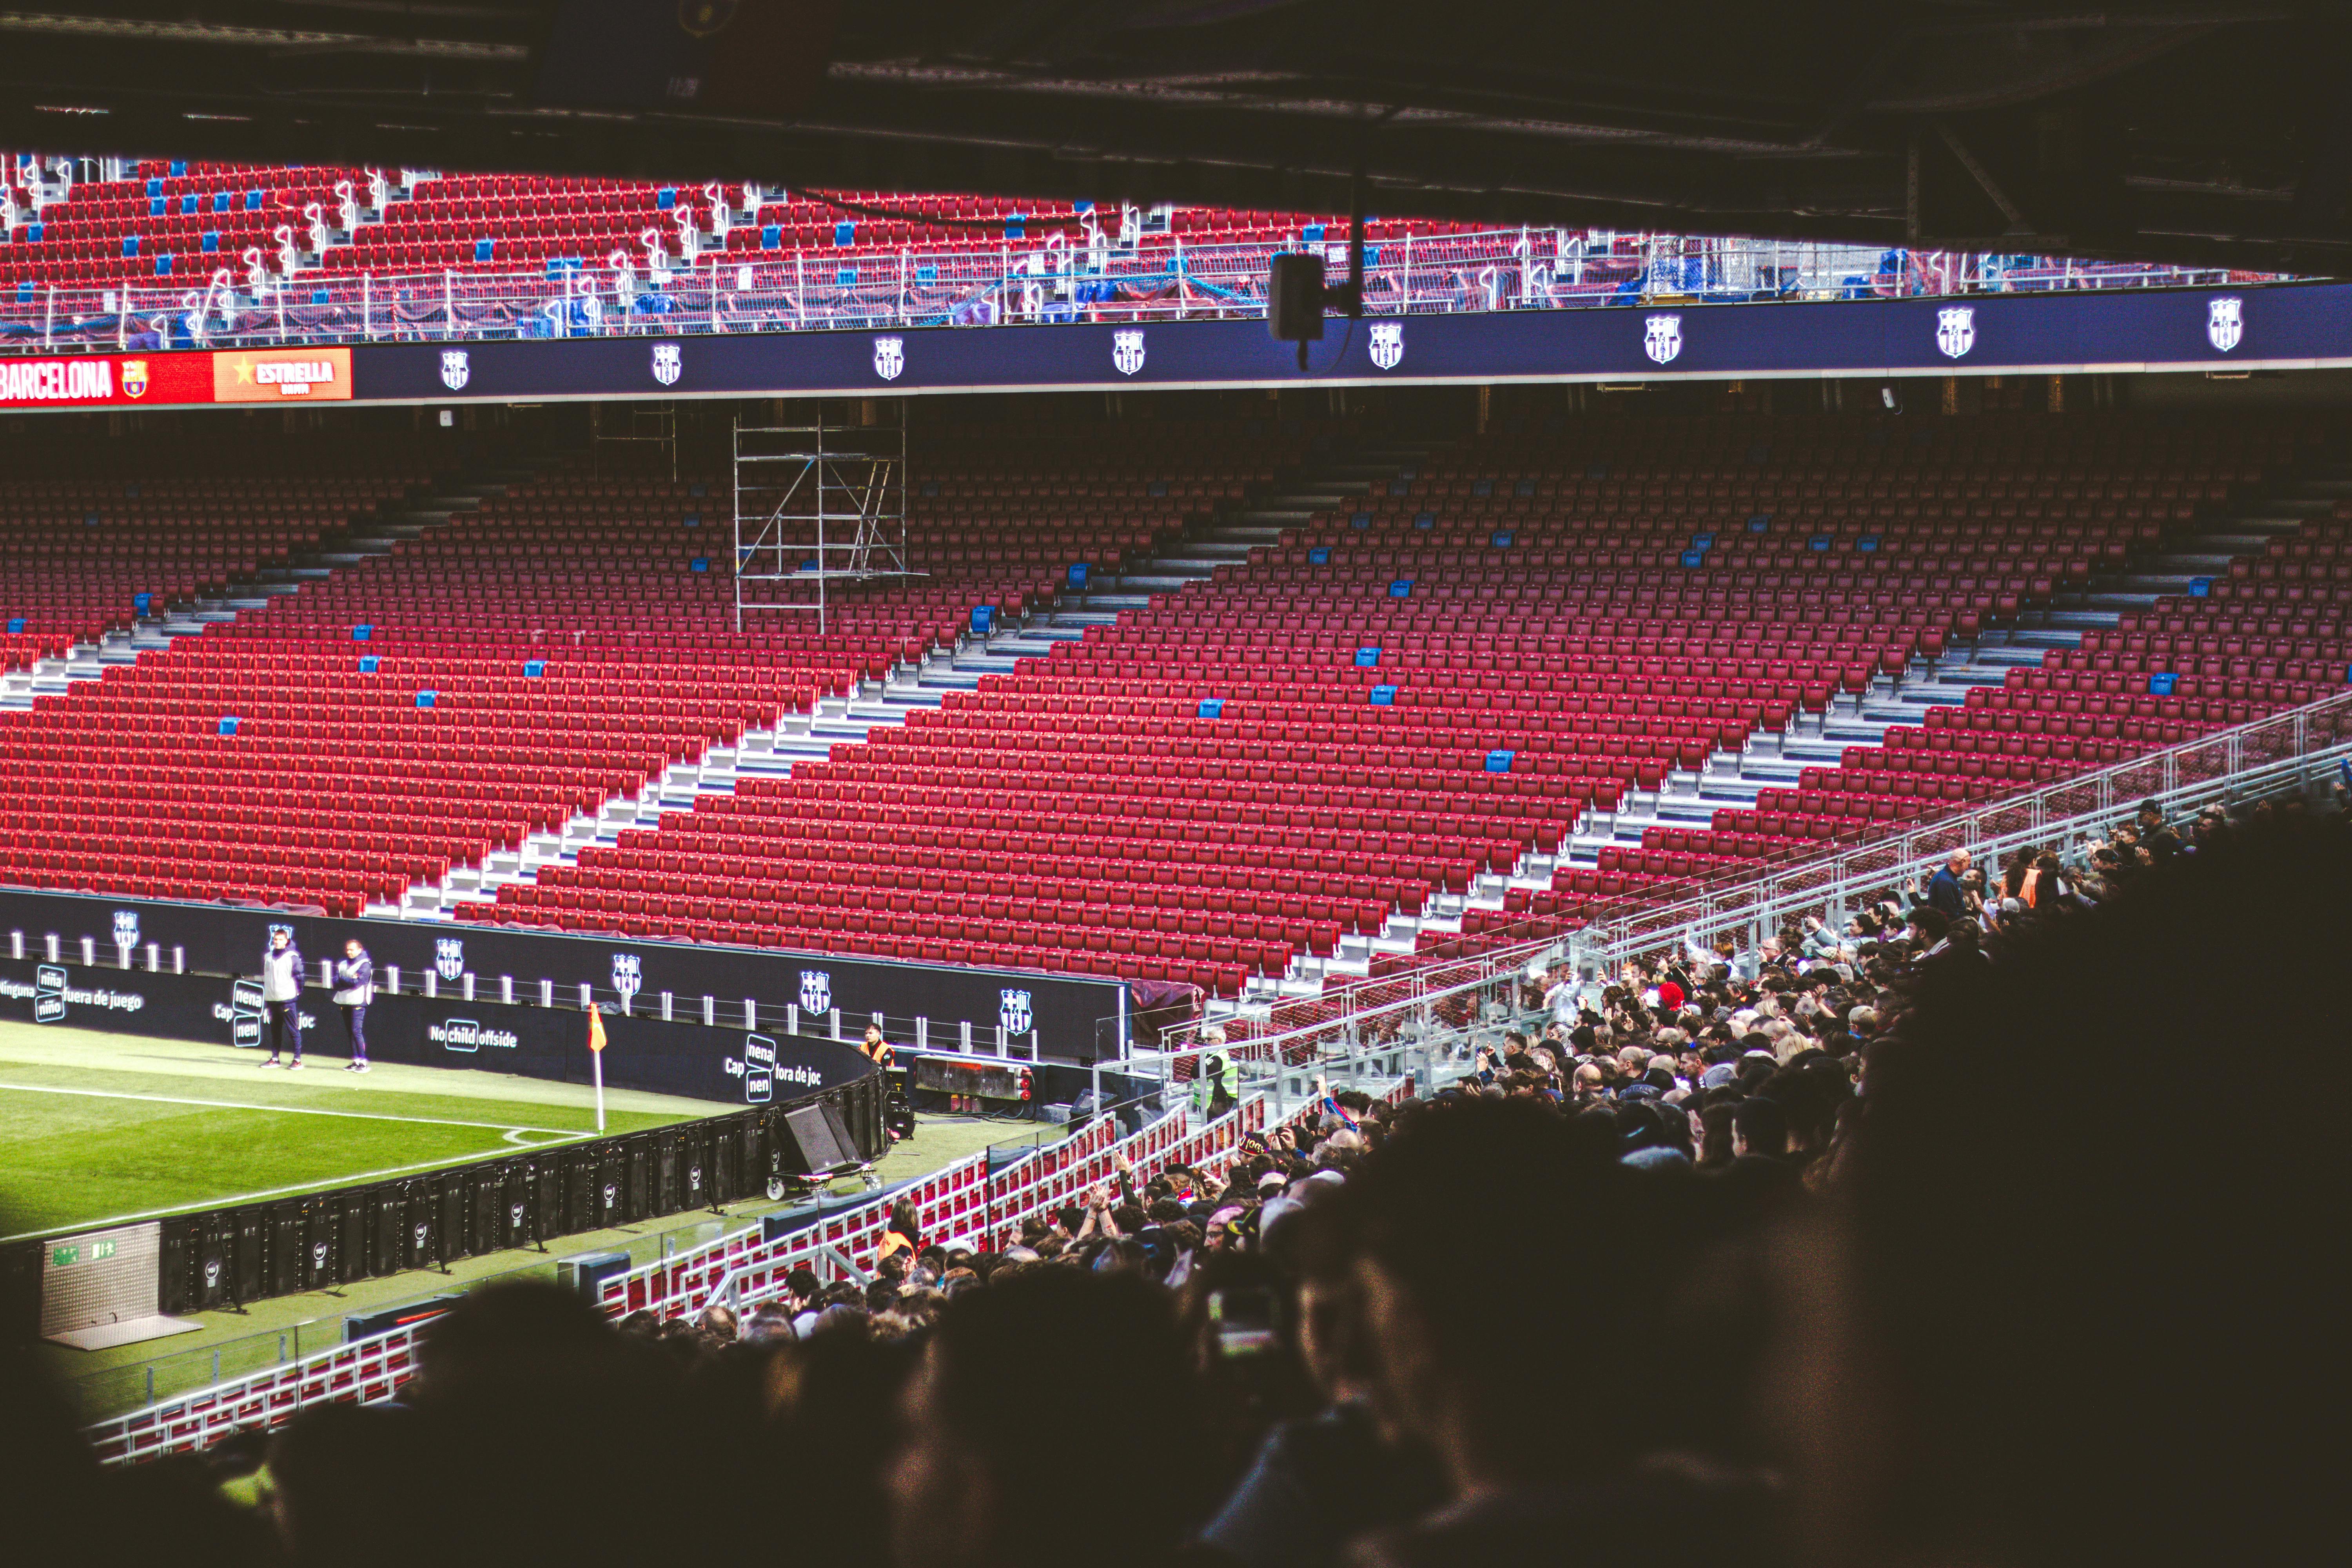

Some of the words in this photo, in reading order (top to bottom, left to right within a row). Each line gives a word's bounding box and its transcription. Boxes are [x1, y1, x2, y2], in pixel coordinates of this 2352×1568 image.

[0, 361, 112, 399] BARCELONA
[257, 362, 333, 383] ESTRELLA
[41, 972, 62, 988] niña
[63, 987, 92, 1005] fuera
[94, 990, 109, 1006] de
[109, 991, 142, 1012] juego
[236, 990, 262, 1007] nena
[39, 1000, 62, 1016] niño
[215, 1004, 233, 1022] Cap
[298, 1012, 314, 1030] joc
[237, 1024, 257, 1037] nen
[431, 1026, 445, 1041] No
[448, 1027, 476, 1044] child
[479, 1030, 517, 1048] offside
[748, 1044, 773, 1062] nena
[726, 1058, 744, 1078] Cap
[775, 1063, 793, 1082] fora
[795, 1066, 806, 1083] de
[808, 1067, 821, 1087] joc
[750, 1079, 769, 1093] nen
